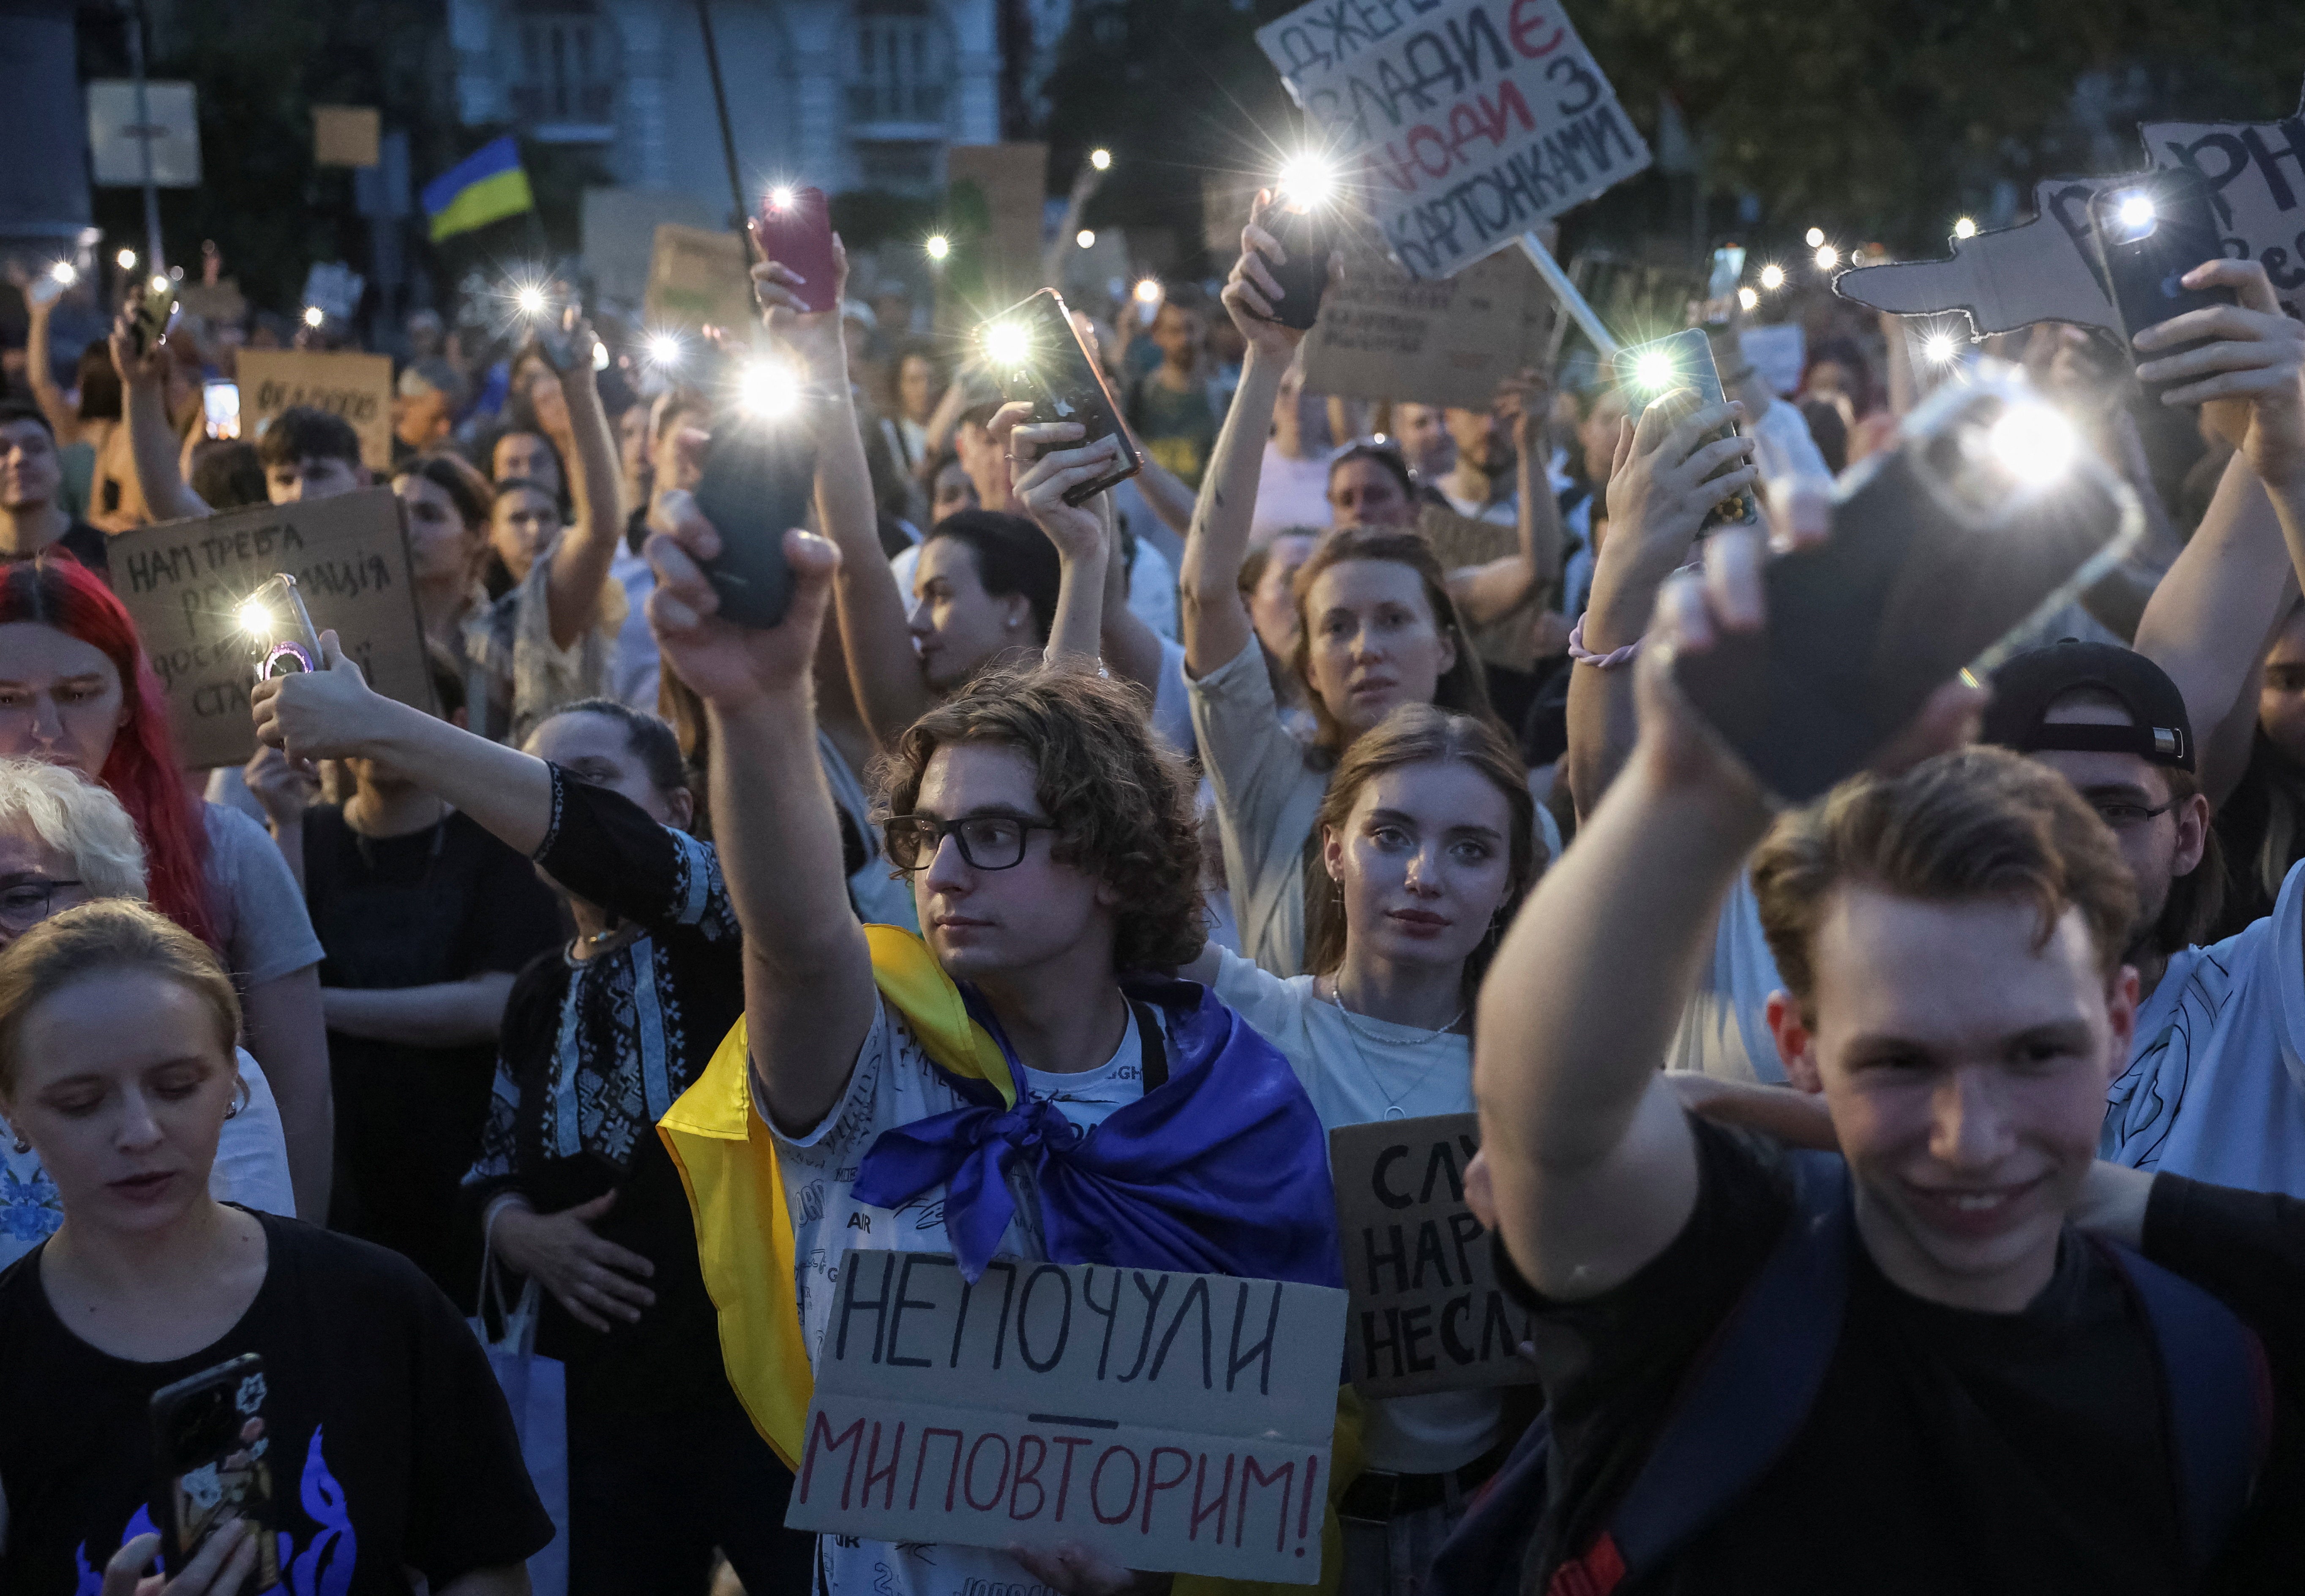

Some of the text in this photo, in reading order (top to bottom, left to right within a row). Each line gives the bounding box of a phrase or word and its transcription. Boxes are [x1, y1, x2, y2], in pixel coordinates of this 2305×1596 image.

[126, 544, 198, 594] НАМ
[846, 1211, 871, 1234] AIR
[1362, 1212, 1484, 1296] НАР
